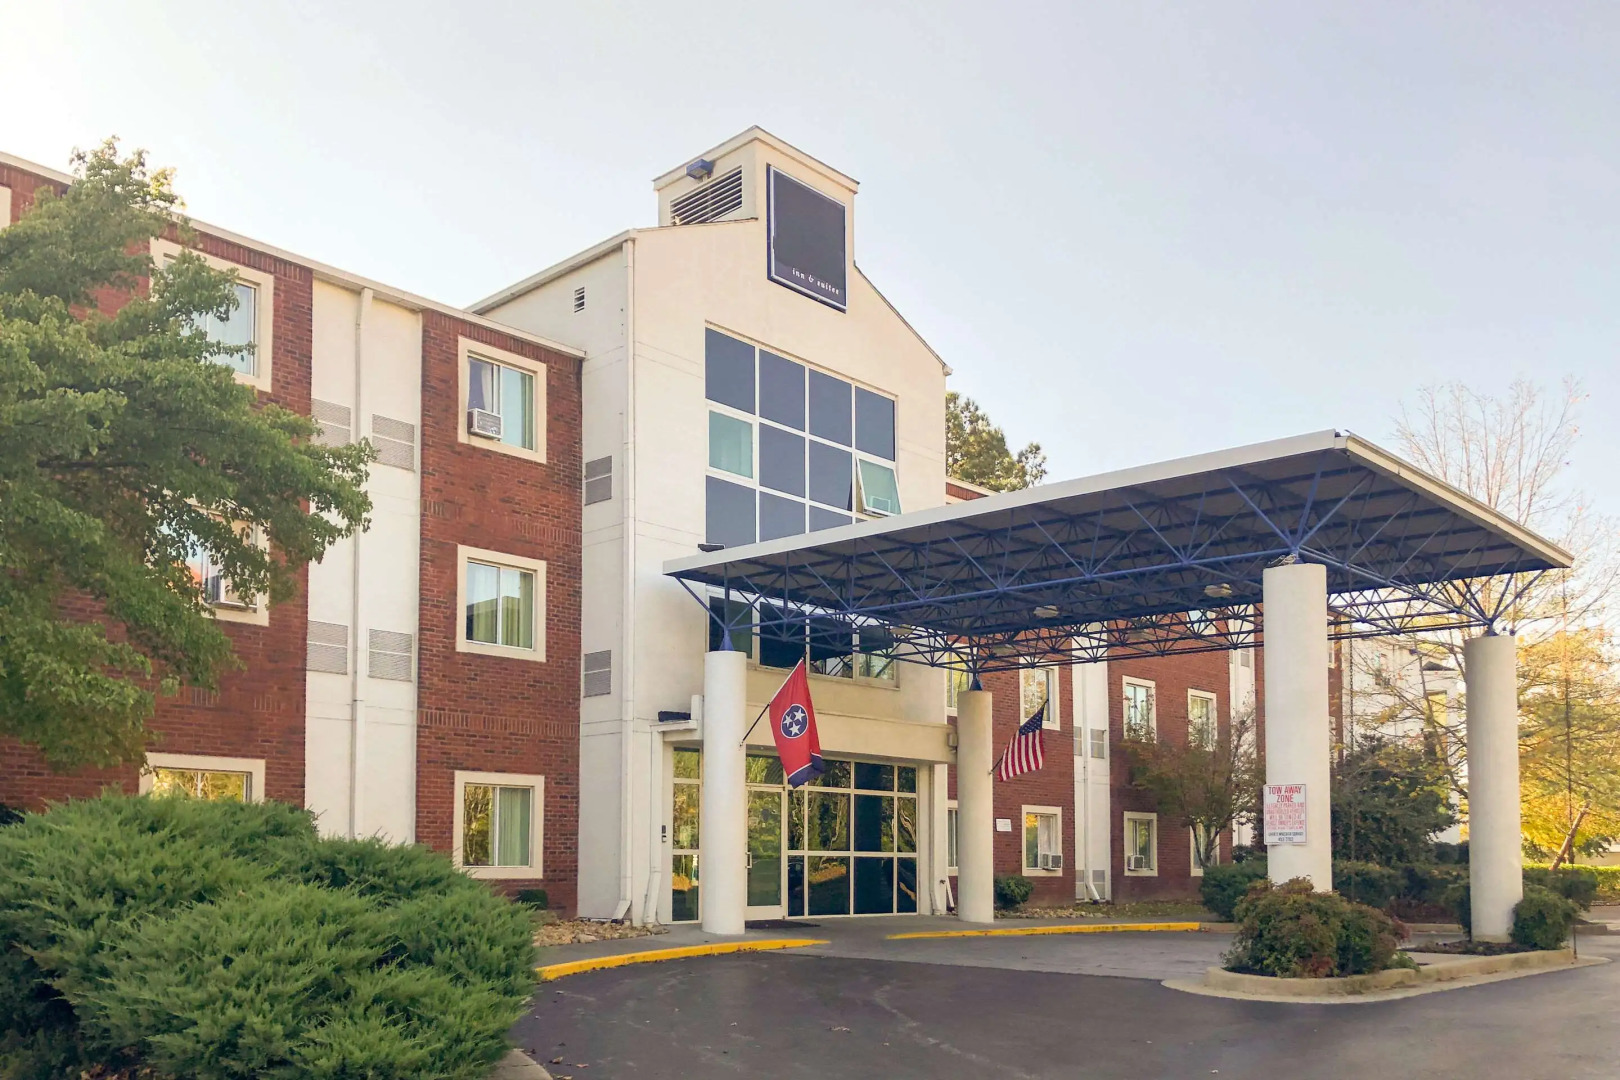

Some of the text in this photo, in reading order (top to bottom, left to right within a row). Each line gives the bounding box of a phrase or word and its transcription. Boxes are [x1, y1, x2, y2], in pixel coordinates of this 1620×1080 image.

[792, 267, 839, 295] inn & suites
[1268, 785, 1302, 795] TOW AWAY
[1276, 794, 1294, 803] ZONE
